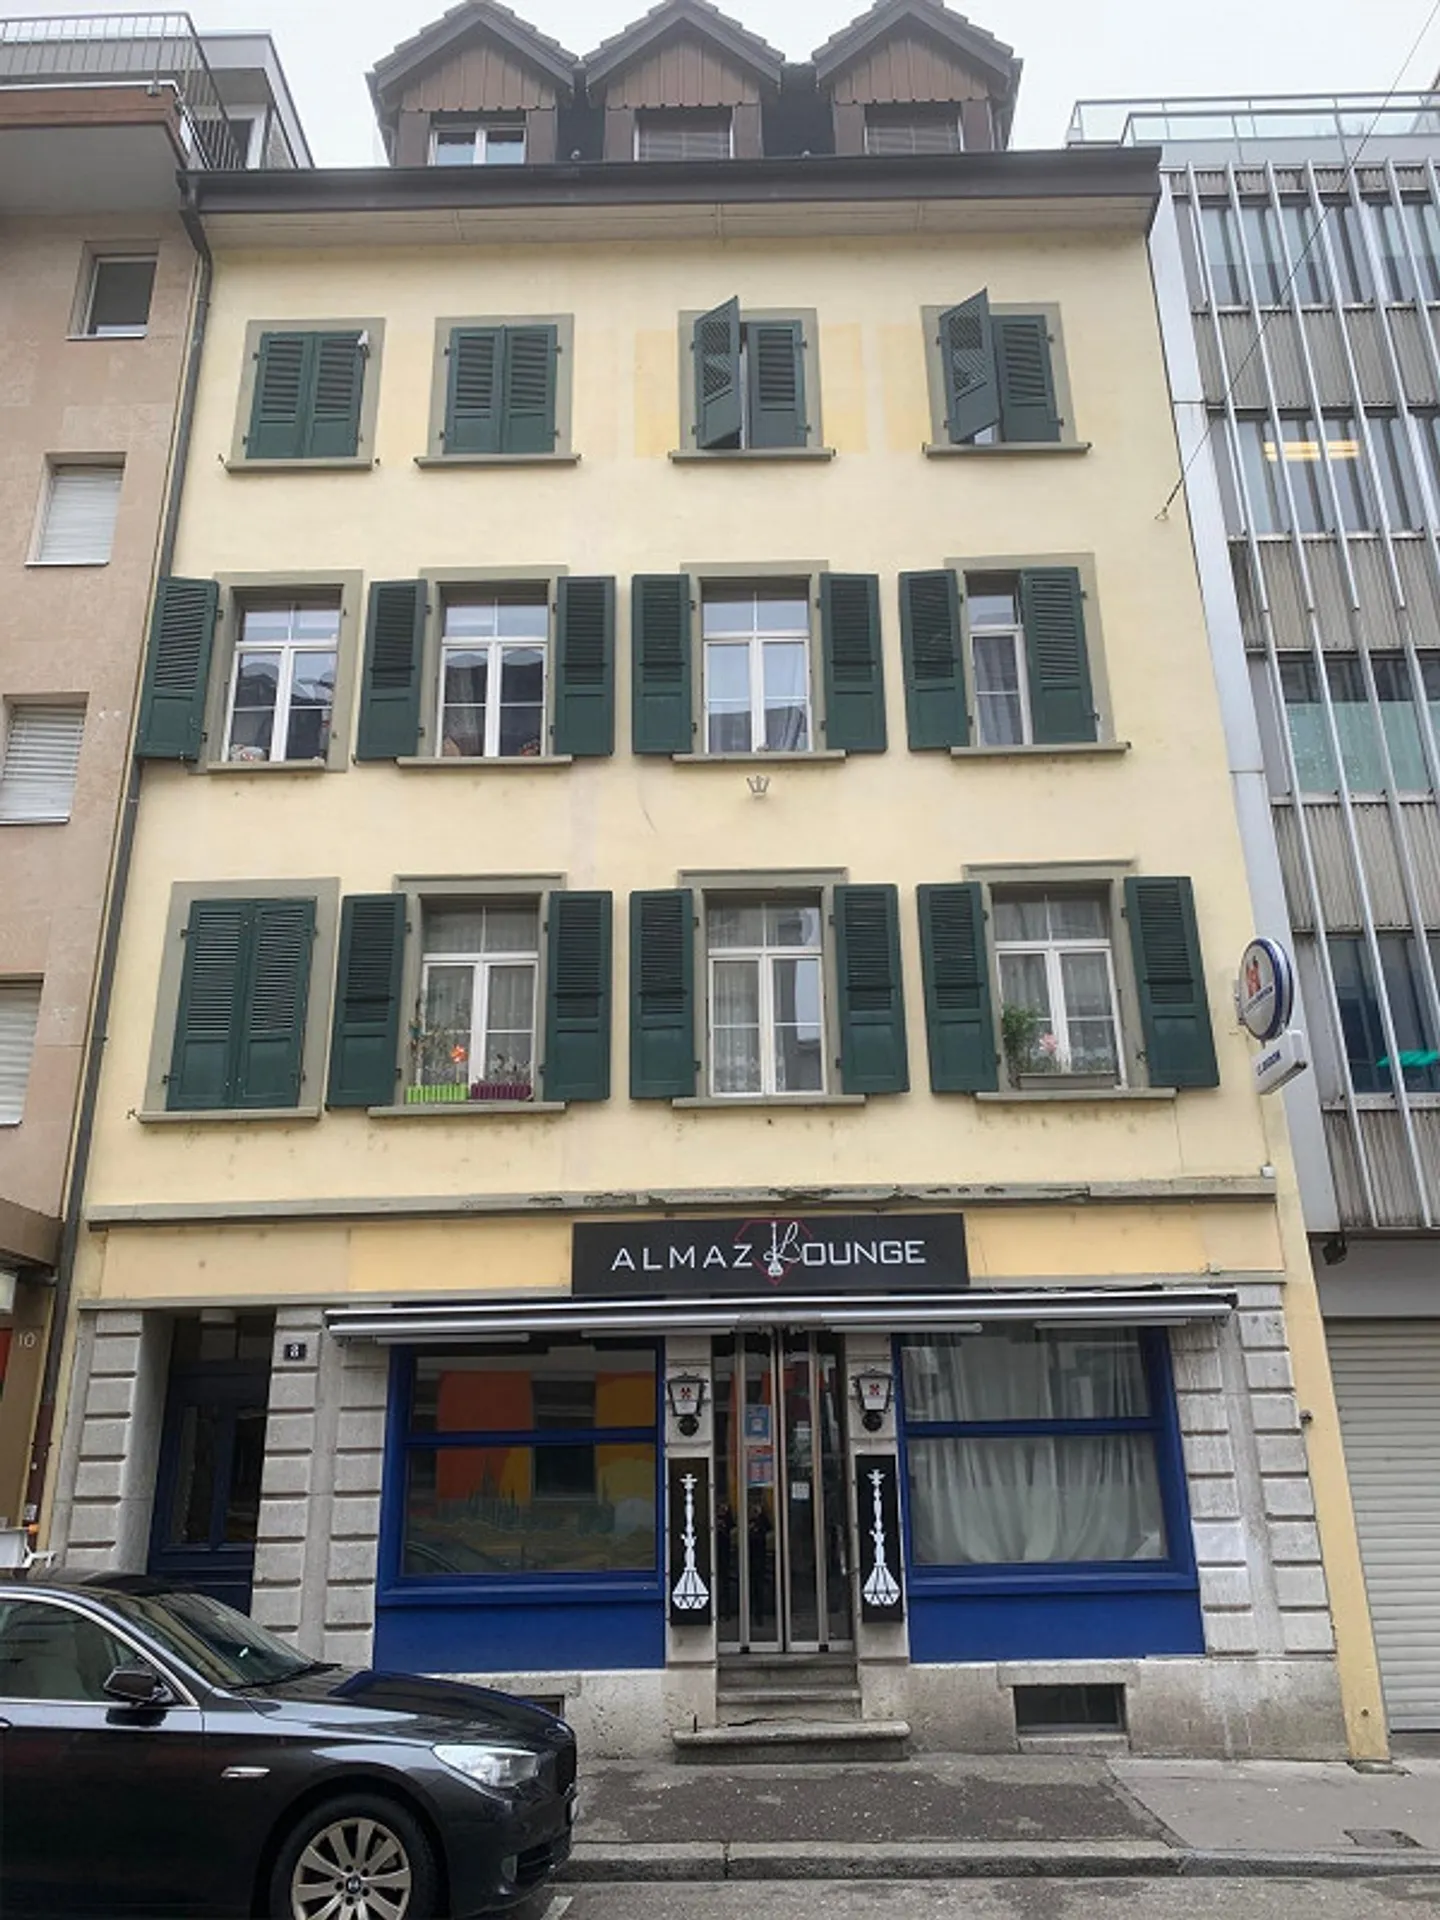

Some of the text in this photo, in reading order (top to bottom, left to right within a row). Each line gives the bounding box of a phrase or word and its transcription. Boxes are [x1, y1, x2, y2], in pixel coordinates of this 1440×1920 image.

[611, 1221, 926, 1271] ALMAZ LOUNGE
[19, 1332, 36, 1348] 10
[290, 1343, 299, 1357] 8
